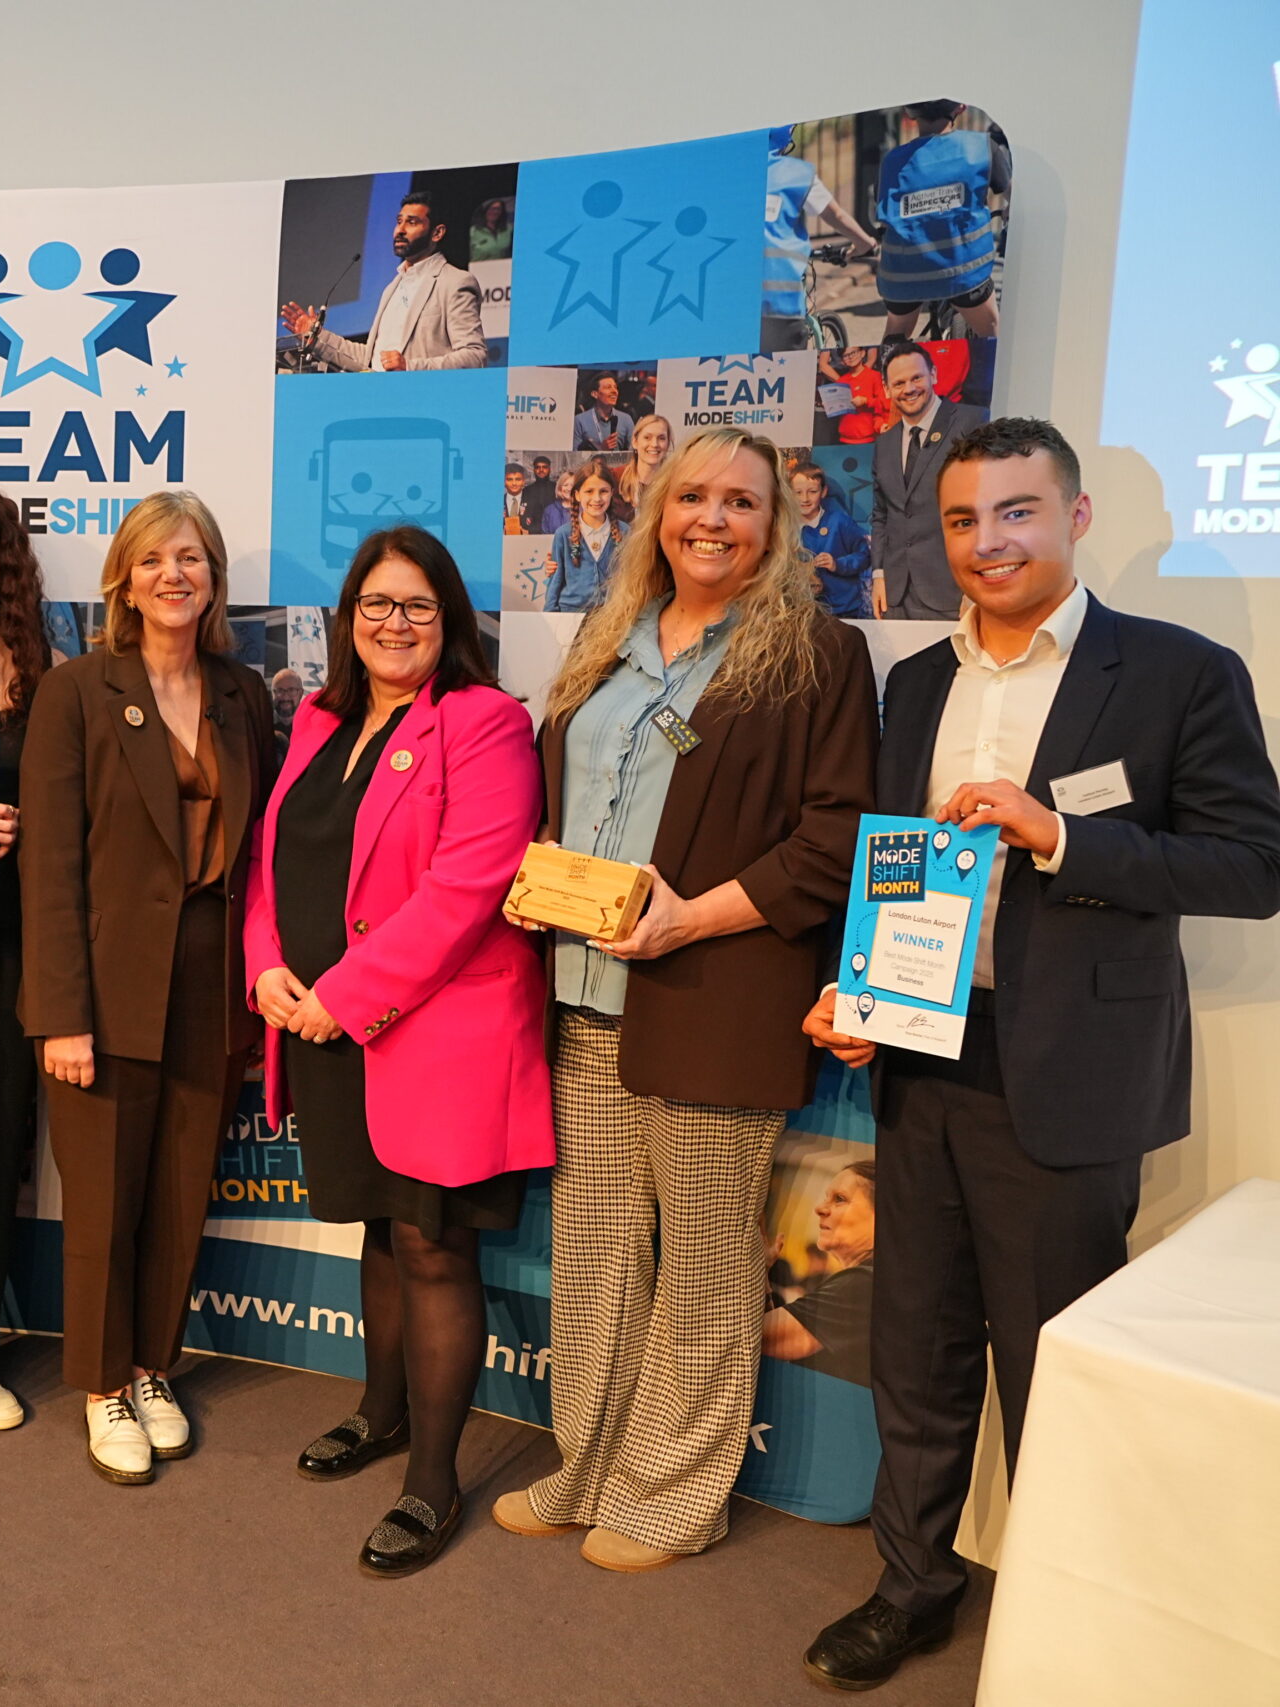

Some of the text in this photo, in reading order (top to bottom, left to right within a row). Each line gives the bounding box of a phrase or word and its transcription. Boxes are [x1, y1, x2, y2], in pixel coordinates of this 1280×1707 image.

[685, 376, 785, 407] TEAM
[873, 848, 921, 866] MODE
[873, 864, 920, 881] SHIFT
[872, 881, 919, 894] MONTH
[888, 910, 957, 930] London Luton Airport
[893, 930, 944, 952] WINNER
[897, 974, 924, 986] Business
[220, 1145, 303, 1176] HIFT
